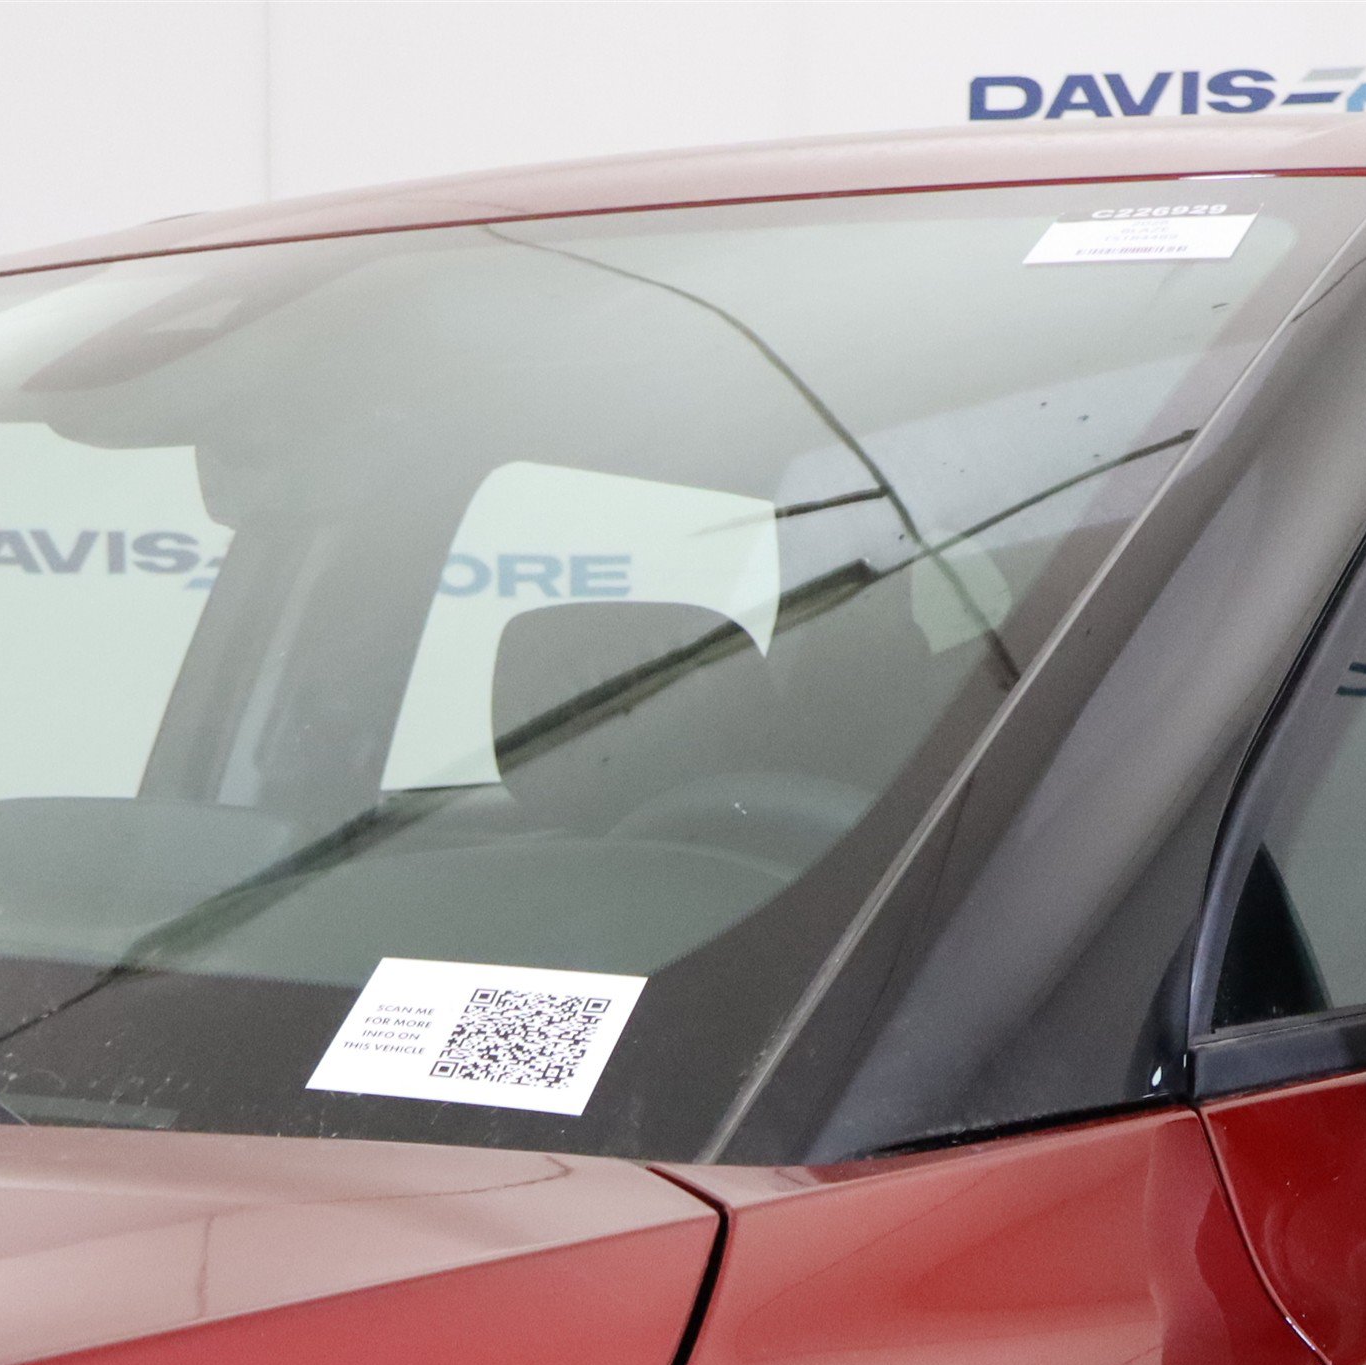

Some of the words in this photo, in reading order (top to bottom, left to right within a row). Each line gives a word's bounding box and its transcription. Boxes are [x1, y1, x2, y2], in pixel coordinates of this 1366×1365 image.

[969, 70, 1277, 121] DAVIS
[1092, 204, 1228, 219] C226929
[438, 552, 632, 597] ORE
[376, 1004, 413, 1014] SCAN
[415, 1007, 435, 1016] ME
[364, 1016, 391, 1026] FOR
[393, 1018, 433, 1029] MORE
[362, 1029, 395, 1039] INFO
[398, 1032, 421, 1041] ON
[343, 1041, 371, 1051] THIS
[375, 1043, 427, 1055] VEHICLE
